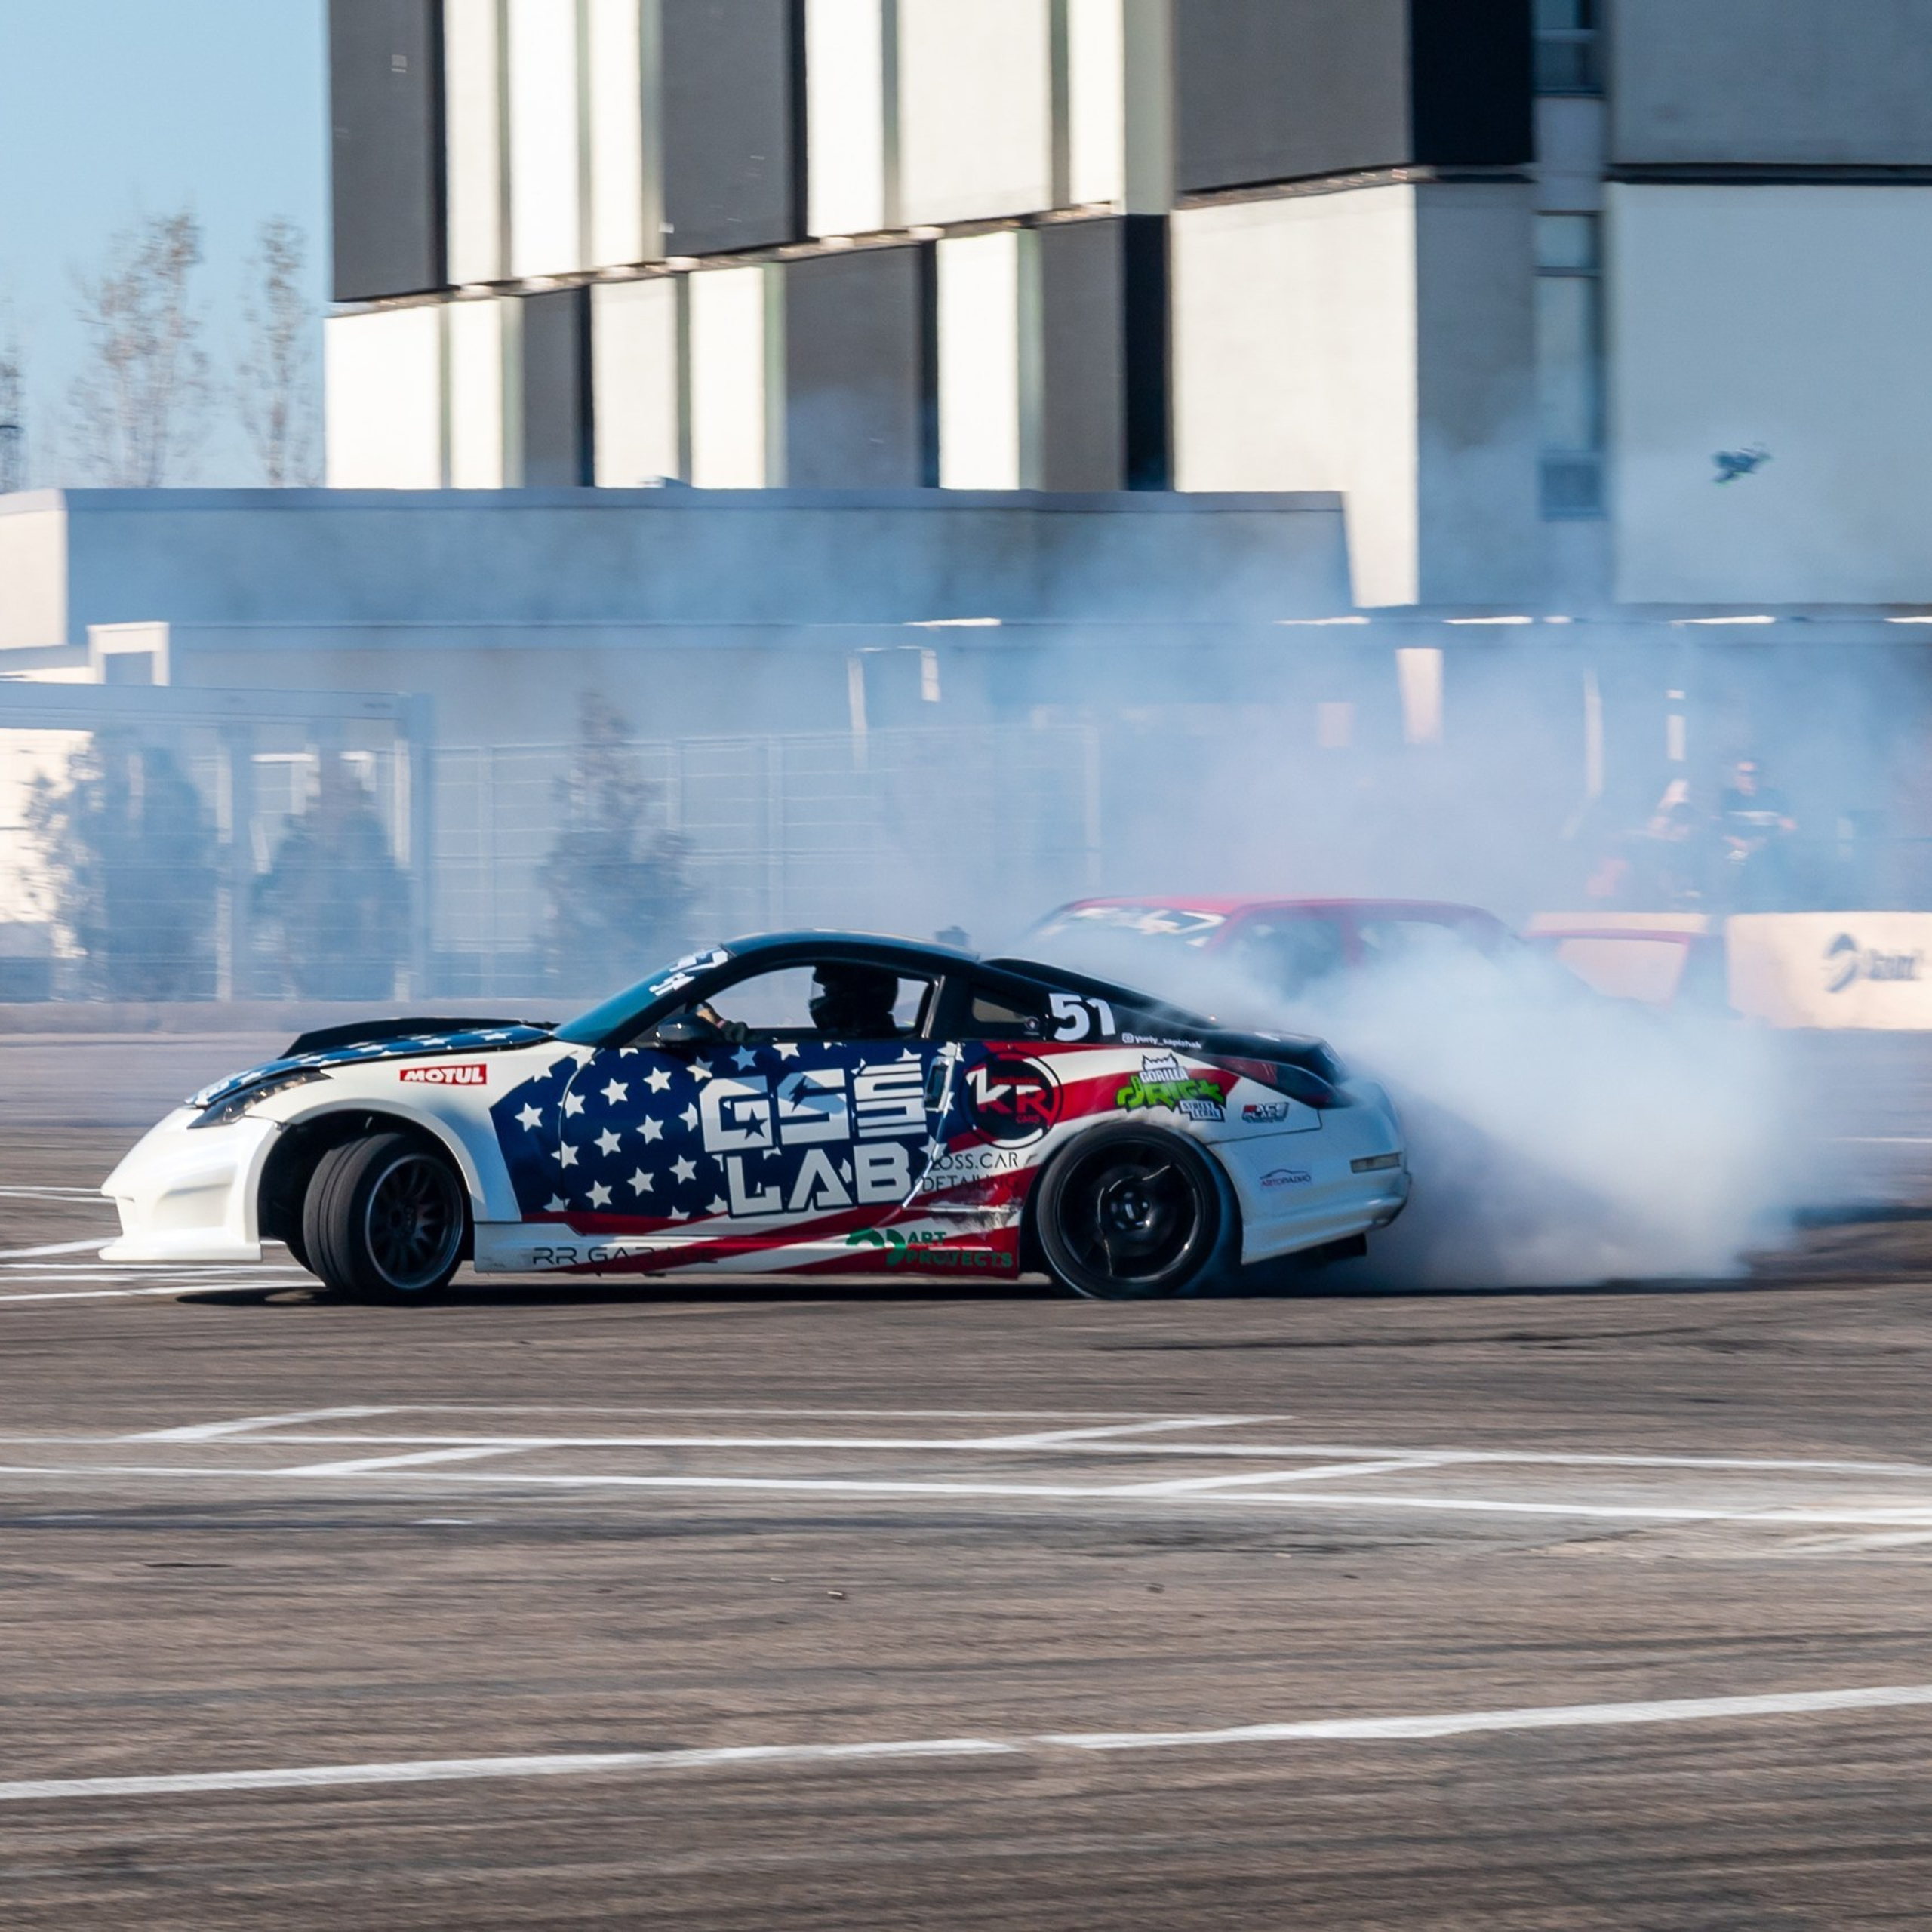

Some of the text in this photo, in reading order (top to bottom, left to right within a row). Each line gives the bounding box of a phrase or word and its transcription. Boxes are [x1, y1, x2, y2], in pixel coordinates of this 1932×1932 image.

[1048, 993, 1116, 1041] 51
[404, 1066, 484, 1084] MOTUL
[1139, 1066, 1189, 1083] GORILLA
[965, 1067, 1056, 1128] KR
[726, 1142, 912, 1214] LAB
[907, 1231, 946, 1245] ART
[533, 1247, 577, 1265] RR
